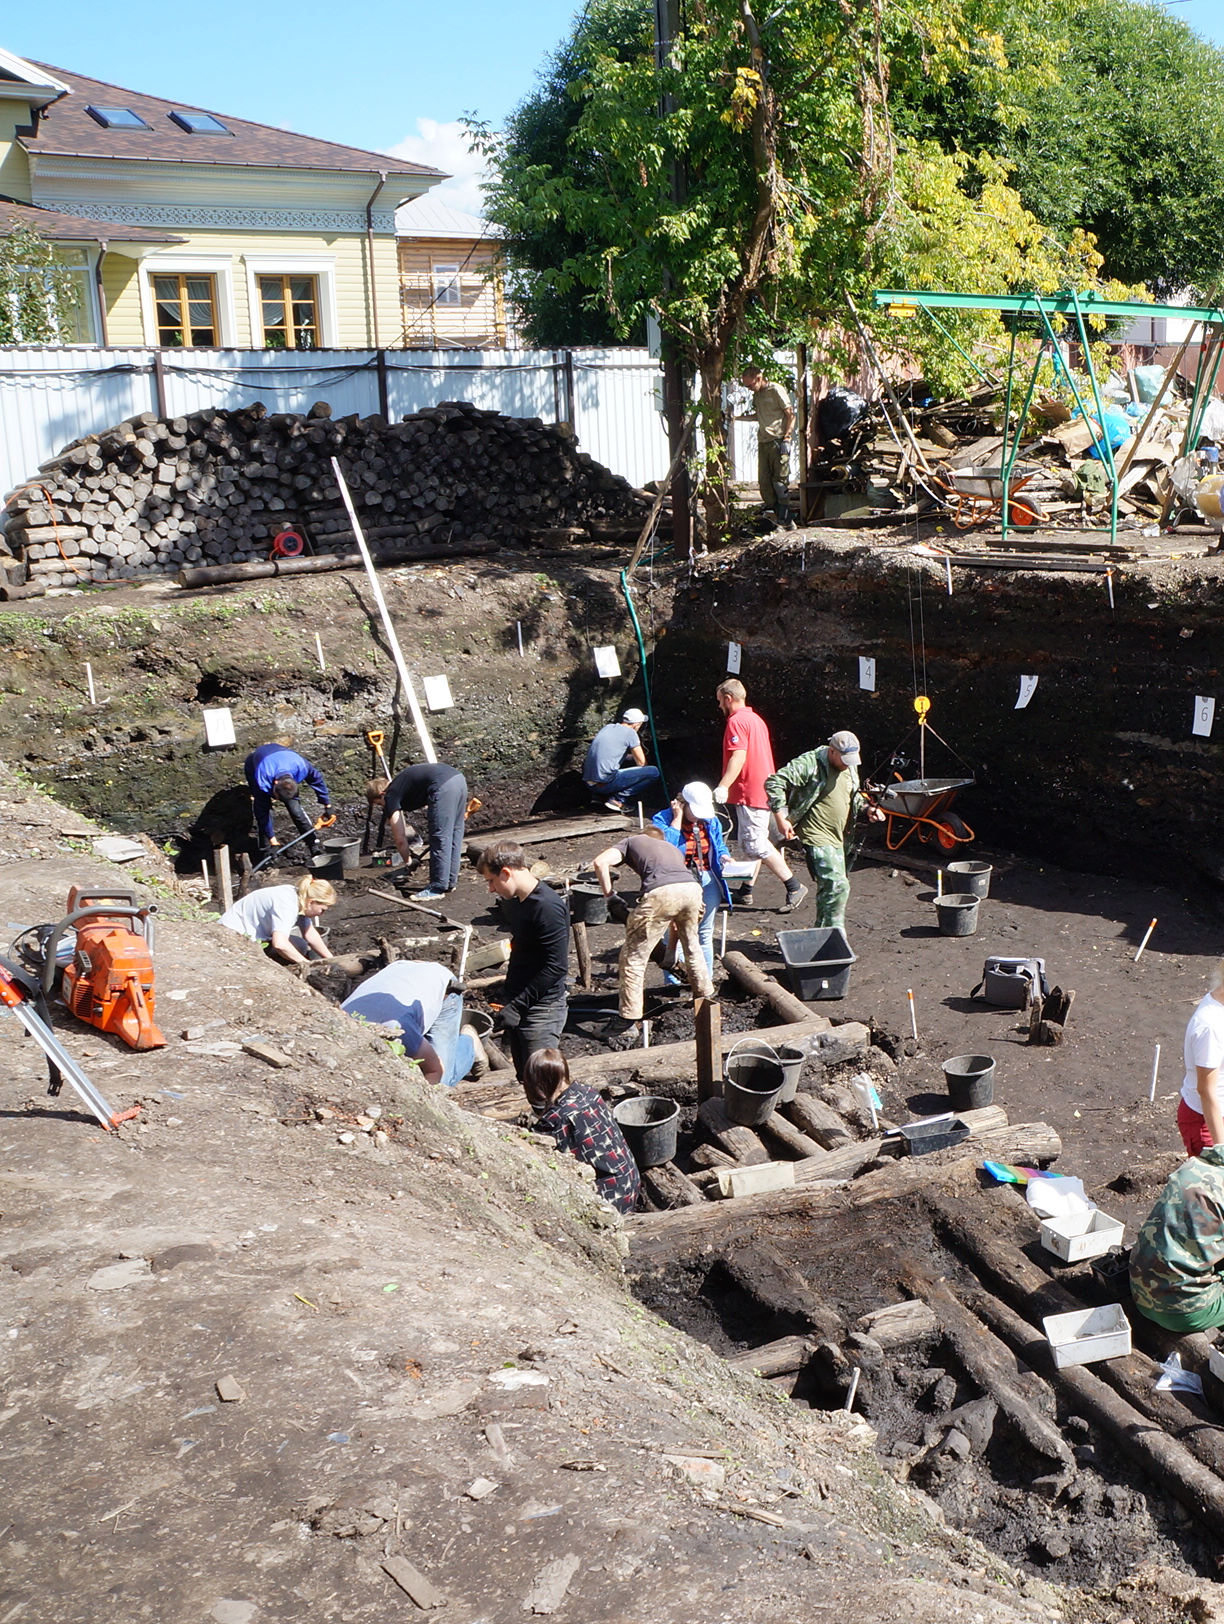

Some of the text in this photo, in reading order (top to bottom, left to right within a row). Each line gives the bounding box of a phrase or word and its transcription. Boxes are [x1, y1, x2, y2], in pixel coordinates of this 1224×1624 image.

[733, 650, 739, 663] 3
[865, 665, 872, 679] 4
[1024, 684, 1032, 698] 5
[1201, 706, 1209, 722] 6
